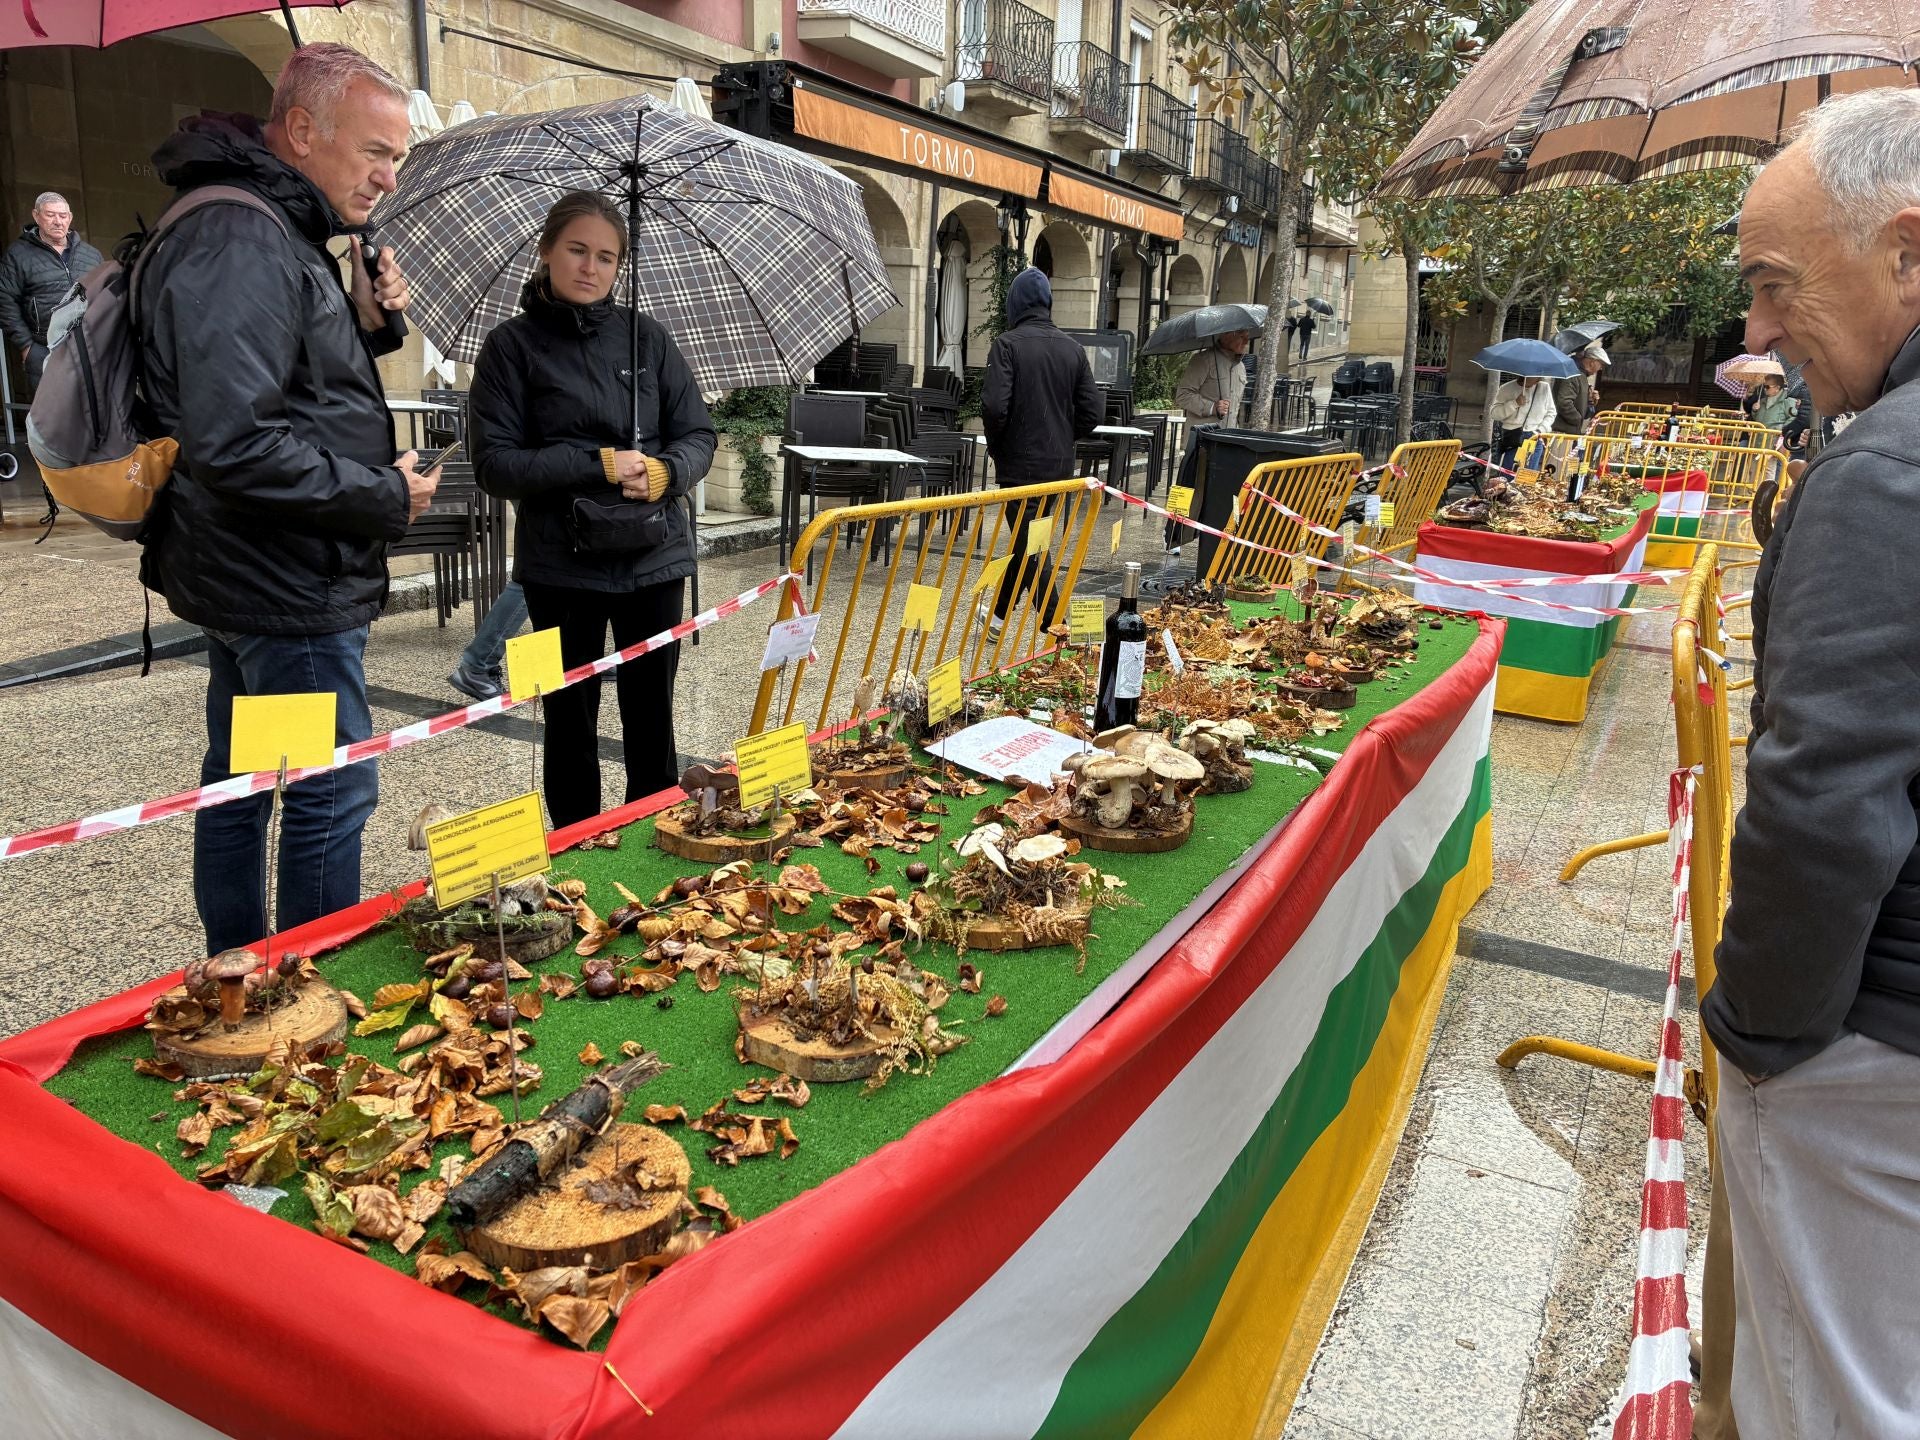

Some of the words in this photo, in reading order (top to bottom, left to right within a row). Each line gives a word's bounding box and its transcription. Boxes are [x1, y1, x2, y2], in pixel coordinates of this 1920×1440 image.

[121, 162, 152, 177] TOR
[899, 127, 976, 179] TORMO
[1103, 193, 1146, 230] TORMO
